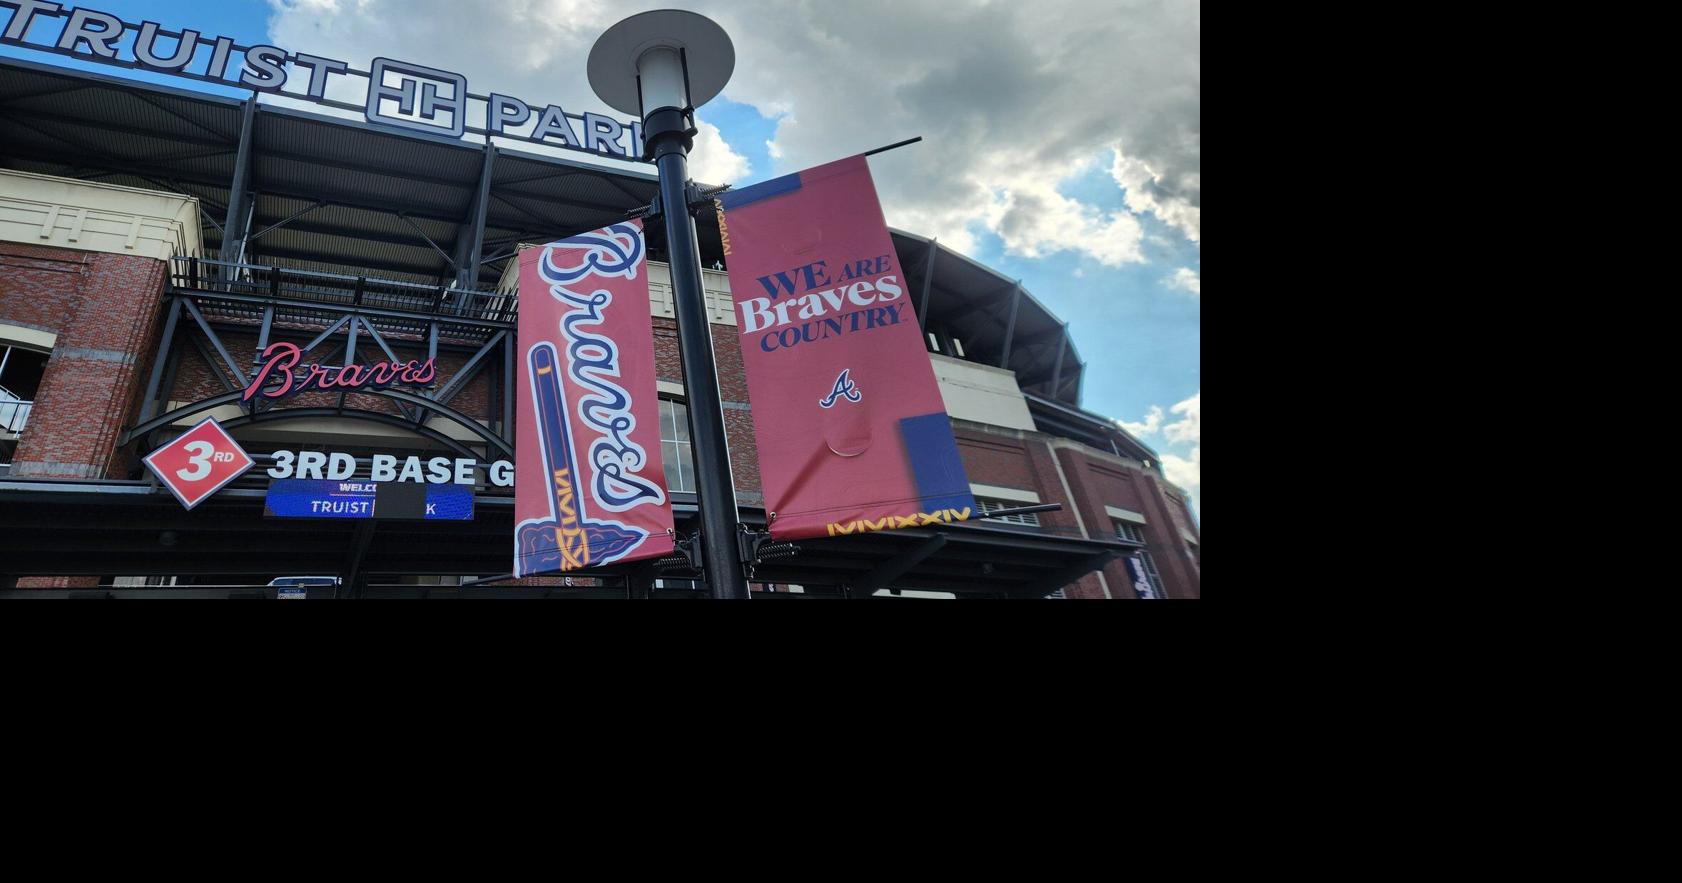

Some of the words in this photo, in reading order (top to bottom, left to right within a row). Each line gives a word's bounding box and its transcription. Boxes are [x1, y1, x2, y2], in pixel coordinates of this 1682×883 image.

[0, 0, 348, 99] TRUIST
[756, 260, 831, 299] WE
[837, 254, 893, 282] ARE
[738, 275, 902, 334] Braves
[760, 302, 905, 353] COUNTRY
[243, 341, 437, 402] Braves
[538, 221, 666, 513] Braves
[266, 450, 356, 481] 3RD
[371, 453, 476, 485] BASE
[311, 501, 370, 514] TRUIST
